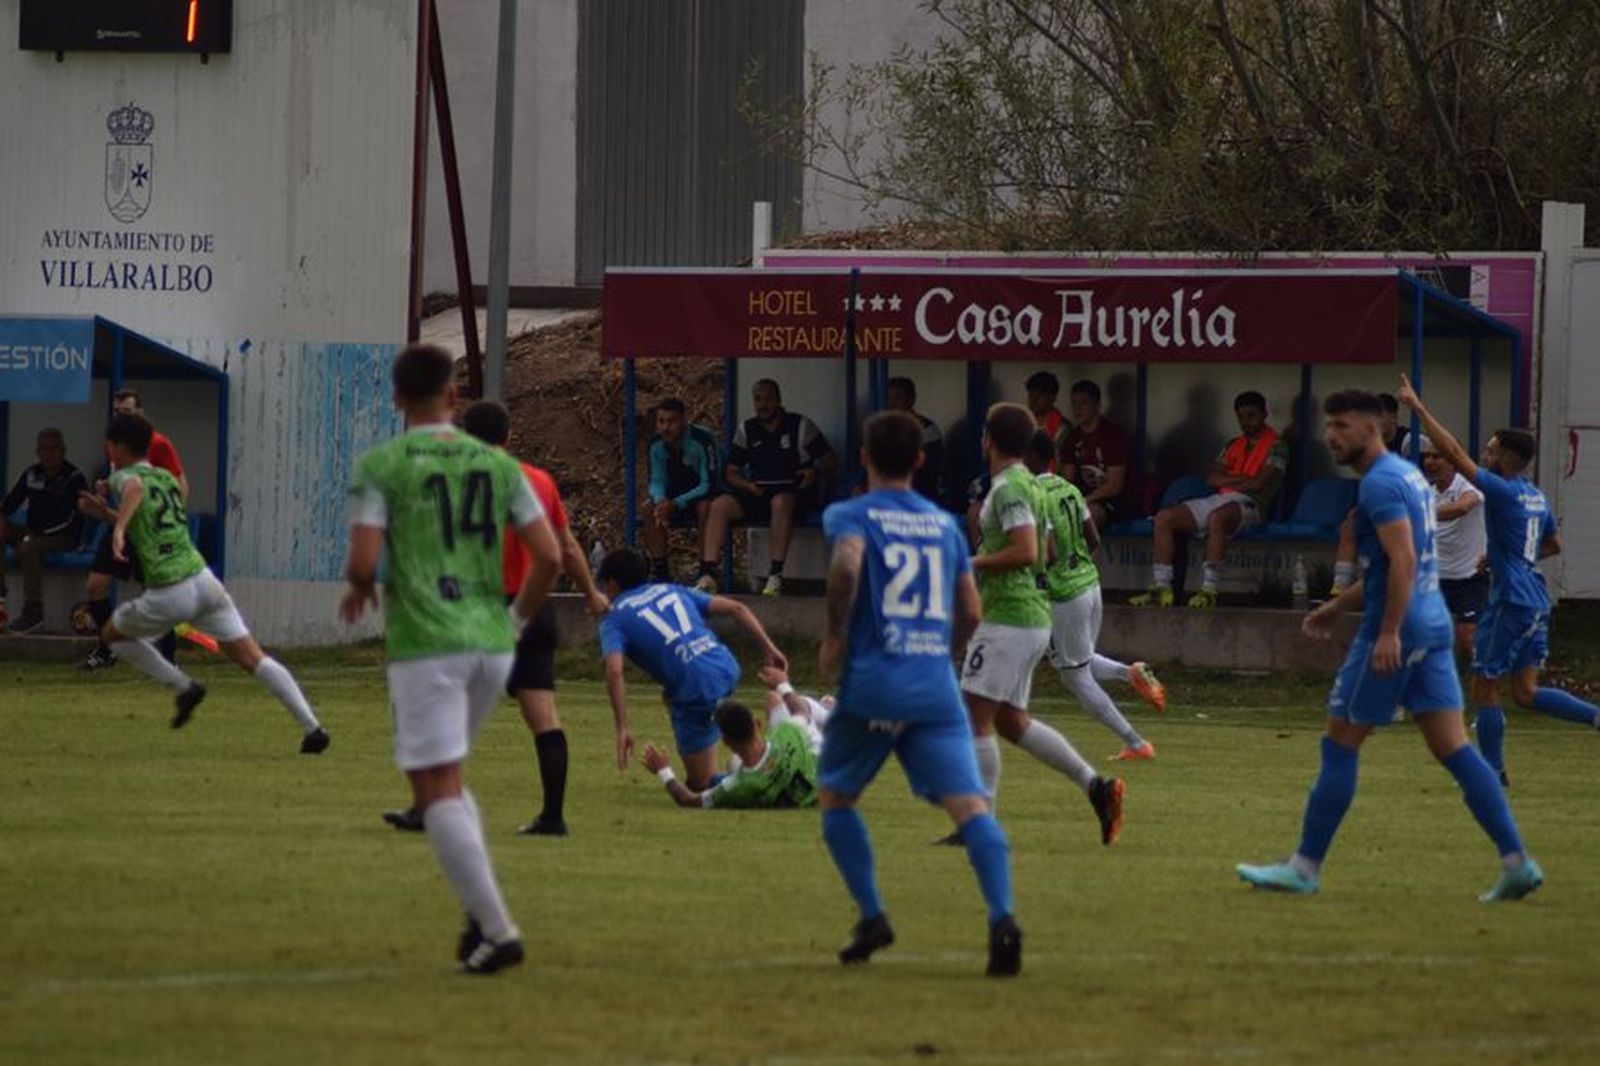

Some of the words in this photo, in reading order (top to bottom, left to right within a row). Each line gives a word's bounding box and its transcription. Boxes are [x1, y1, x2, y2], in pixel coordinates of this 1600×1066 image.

[41, 230, 185, 251] AYUNTAMIENTO
[191, 234, 214, 253] DE
[41, 260, 213, 292] VILLARALBO
[748, 290, 817, 315] HOTEL
[914, 287, 1044, 346] Casa
[421, 469, 497, 551] 14
[882, 541, 947, 620] 21
[636, 591, 693, 646] 17
[969, 644, 984, 670] 6
